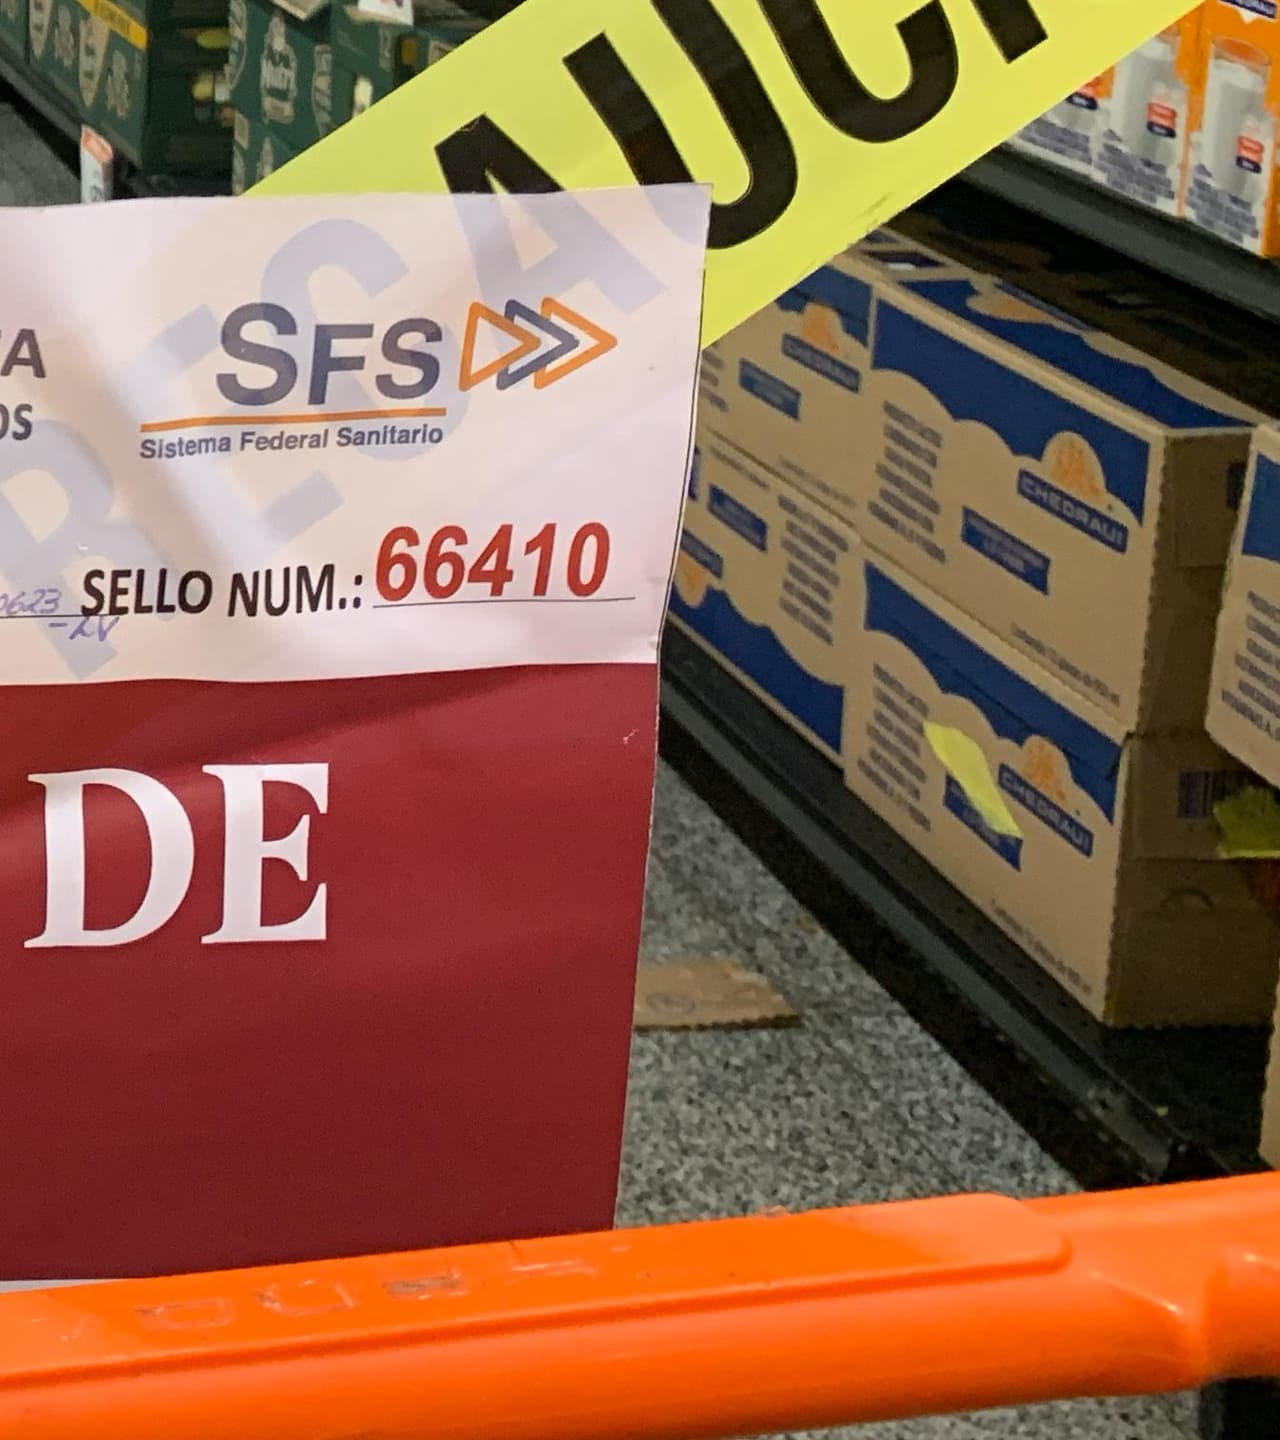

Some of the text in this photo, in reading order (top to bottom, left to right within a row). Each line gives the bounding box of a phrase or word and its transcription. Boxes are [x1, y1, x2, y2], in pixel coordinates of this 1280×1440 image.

[216, 301, 443, 406] SFS
[140, 423, 444, 459] Sistema Federal Sanitario
[1021, 474, 1127, 552] CHEDRAUI
[81, 522, 611, 617] SELLO NUM.: 66410
[24, 762, 333, 952] DE
[1001, 766, 1093, 857] CHEDRAUI
